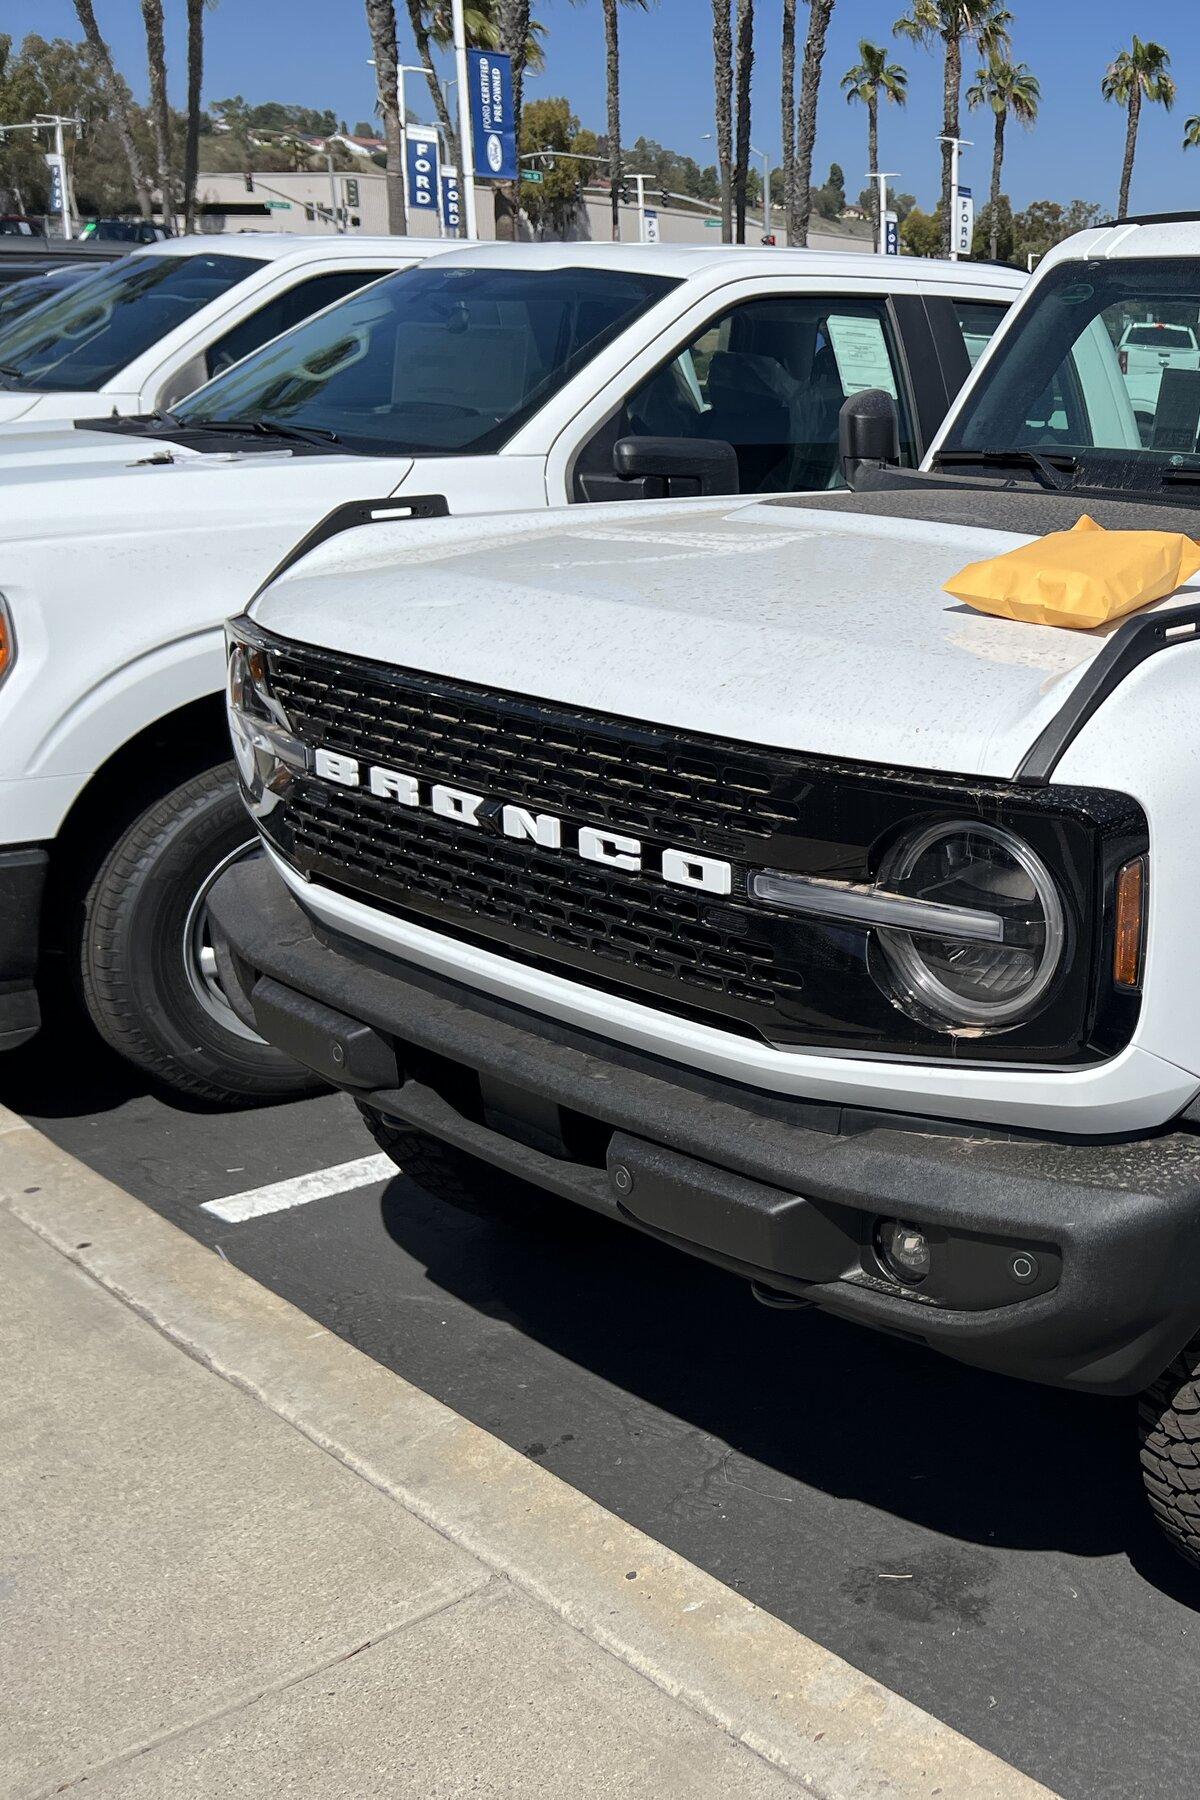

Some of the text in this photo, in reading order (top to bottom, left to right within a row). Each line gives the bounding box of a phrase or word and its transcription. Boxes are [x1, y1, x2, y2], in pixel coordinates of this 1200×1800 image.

[479, 57, 491, 129] FORD CERTIFIED
[491, 67, 502, 123] PRE-OWNED
[53, 166, 62, 208] FORD
[414, 143, 432, 205] FORD
[446, 178, 460, 225] FORD
[960, 201, 969, 249] FORD
[314, 748, 732, 896] BRONCO
